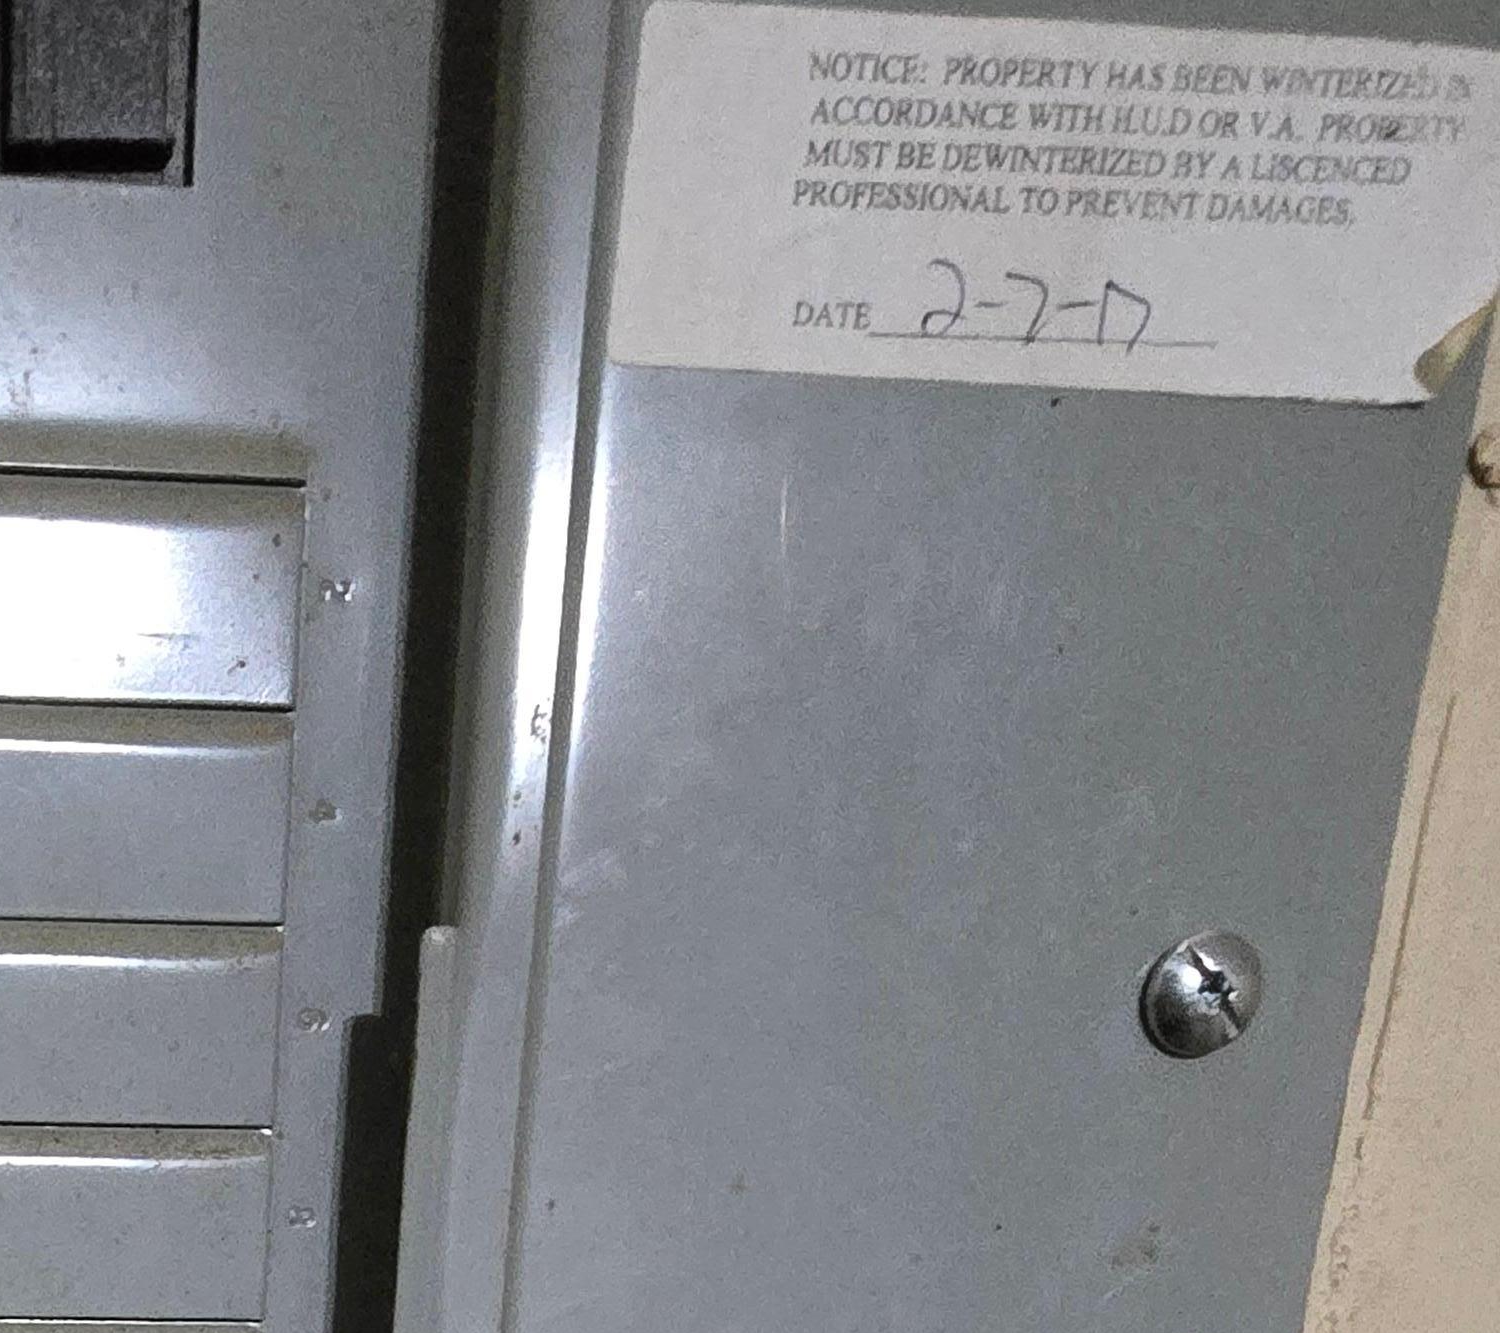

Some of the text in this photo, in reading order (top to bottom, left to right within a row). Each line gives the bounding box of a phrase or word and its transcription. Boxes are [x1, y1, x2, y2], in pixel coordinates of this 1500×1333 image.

[808, 51, 927, 85] NOTICE:
[943, 54, 1102, 89] PROPERTY
[1106, 58, 1166, 92] HAS
[1169, 63, 1250, 95] BEEN
[1259, 64, 1439, 100] WINTERIZED
[810, 96, 1022, 131] ACCORDANCE
[1028, 101, 1104, 133] WITH
[1199, 109, 1240, 139] OR
[1316, 112, 1467, 144] PROPERTY
[803, 138, 1413, 185] MUST BE DEWINTERIZED BY A LISCENCED
[794, 178, 1011, 214] PROFESSIONAL
[1019, 185, 1061, 216] TO
[1064, 188, 1199, 221] PREVENT
[793, 301, 873, 330] DATE
